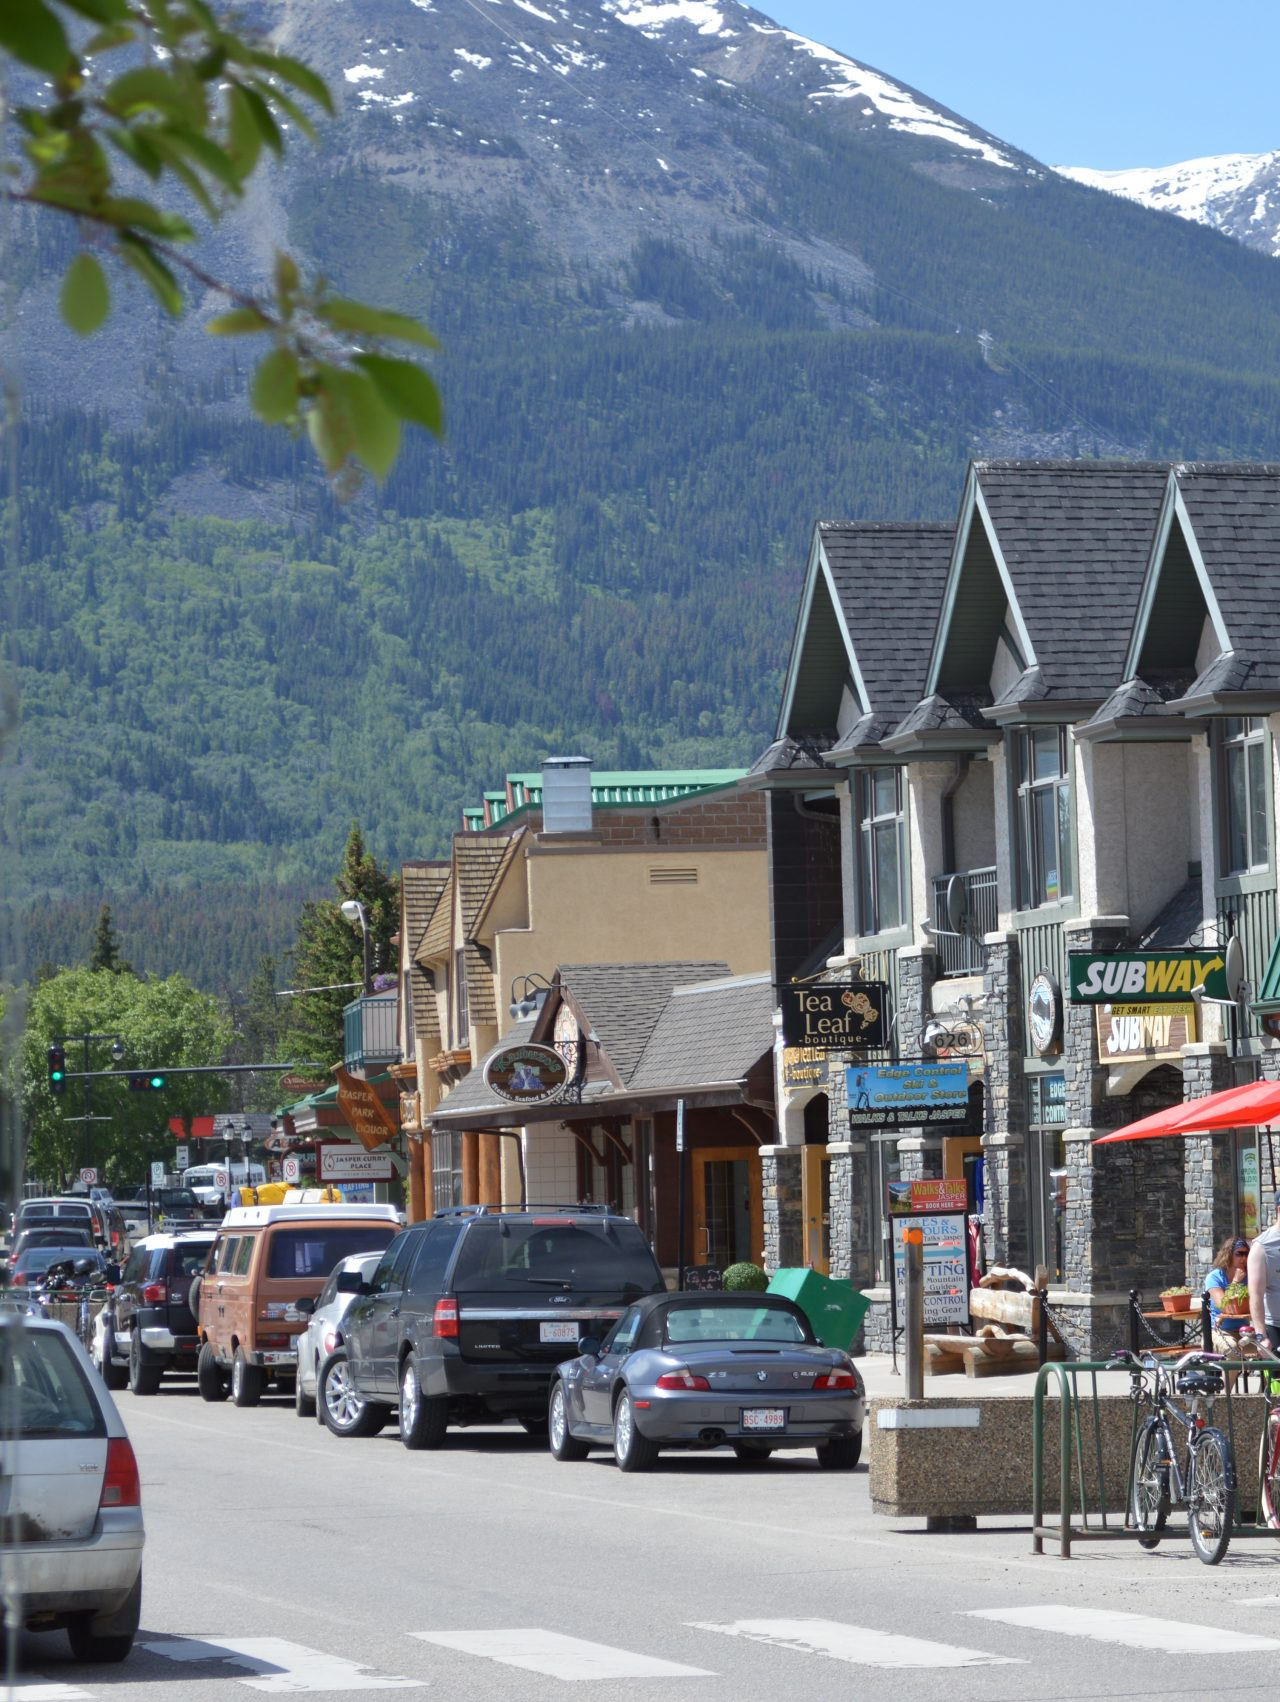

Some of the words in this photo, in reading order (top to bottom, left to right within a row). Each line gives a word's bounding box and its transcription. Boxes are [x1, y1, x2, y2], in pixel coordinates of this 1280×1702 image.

[1077, 955, 1224, 997] SUBWAY
[794, 990, 832, 1012] Tea
[1112, 1007, 1125, 1015] GET
[1127, 1006, 1151, 1015] SMART
[806, 1010, 852, 1035] Leaf
[935, 1033, 968, 1049] 626
[1106, 1015, 1172, 1055] SUBWAY
[876, 1068, 910, 1079] Edge
[914, 1066, 962, 1077] Control
[903, 1079, 925, 1089] Ski
[928, 1079, 938, 1088] &
[340, 1089, 374, 1102] JASPER
[874, 1091, 928, 1102] Outdoor
[931, 1090, 967, 1100] Store
[351, 1107, 375, 1118] PARK
[851, 1112, 886, 1124] WALKS
[887, 1112, 895, 1122] &
[897, 1110, 928, 1122] TALKS
[929, 1108, 967, 1120] JASPER
[355, 1124, 388, 1136] LIQUOR
[937, 1193, 965, 1201] JASPER
[927, 1275, 964, 1283] Mountain
[929, 1283, 957, 1291] Guides
[923, 1295, 966, 1306] CONTROL
[941, 1306, 962, 1314] Gear
